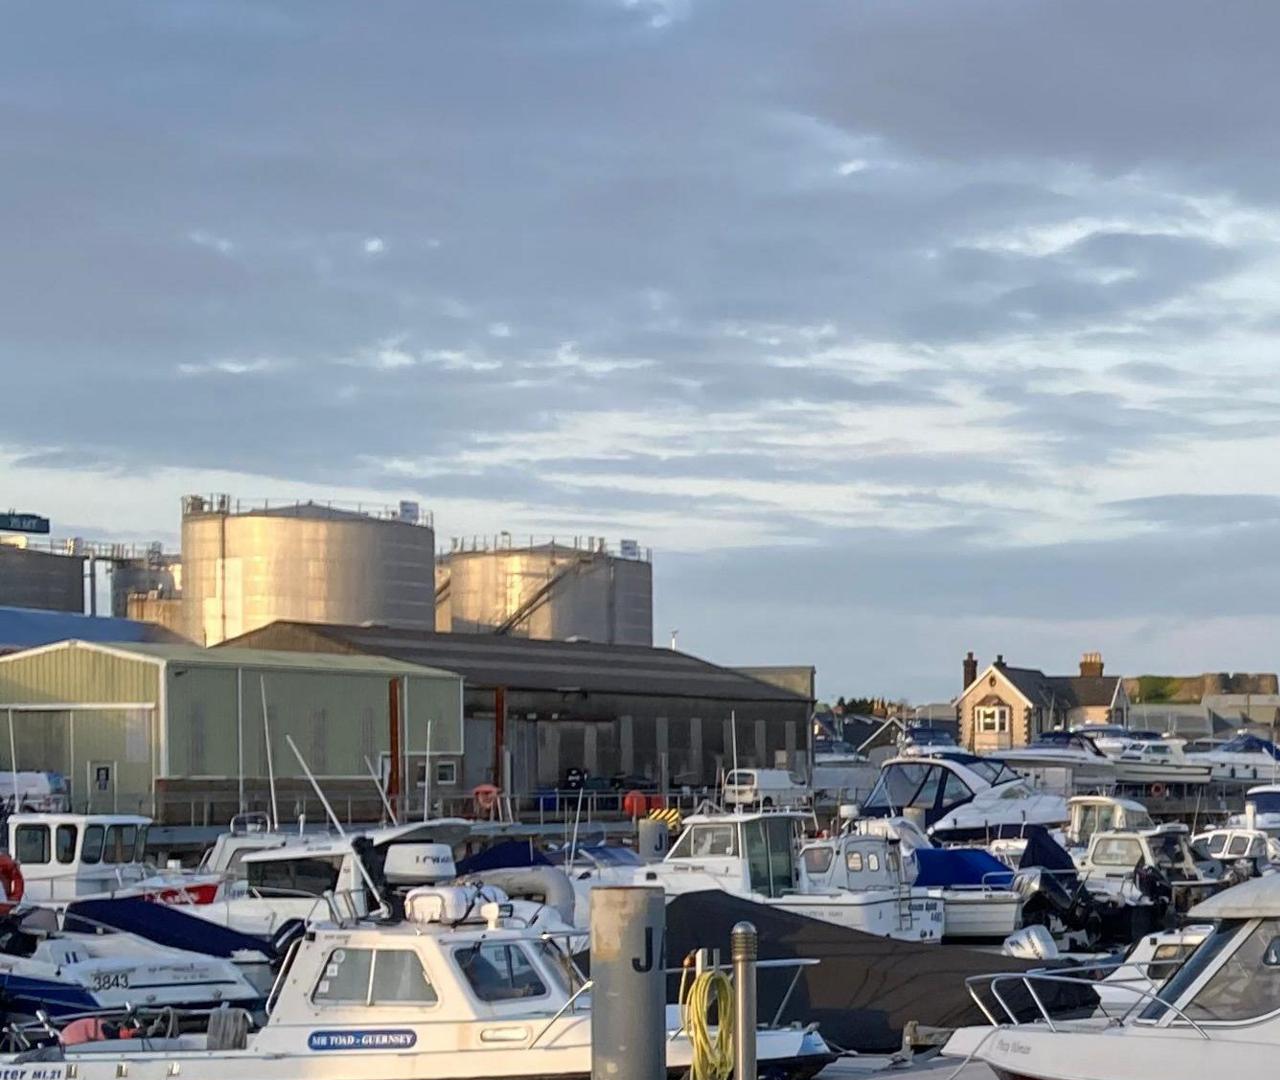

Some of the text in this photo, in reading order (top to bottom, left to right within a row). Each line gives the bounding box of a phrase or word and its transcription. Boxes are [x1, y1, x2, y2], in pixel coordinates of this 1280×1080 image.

[92, 974, 129, 992] 3843
[329, 1035, 354, 1046] TOAD
[361, 1034, 414, 1045] GUERNSEY
